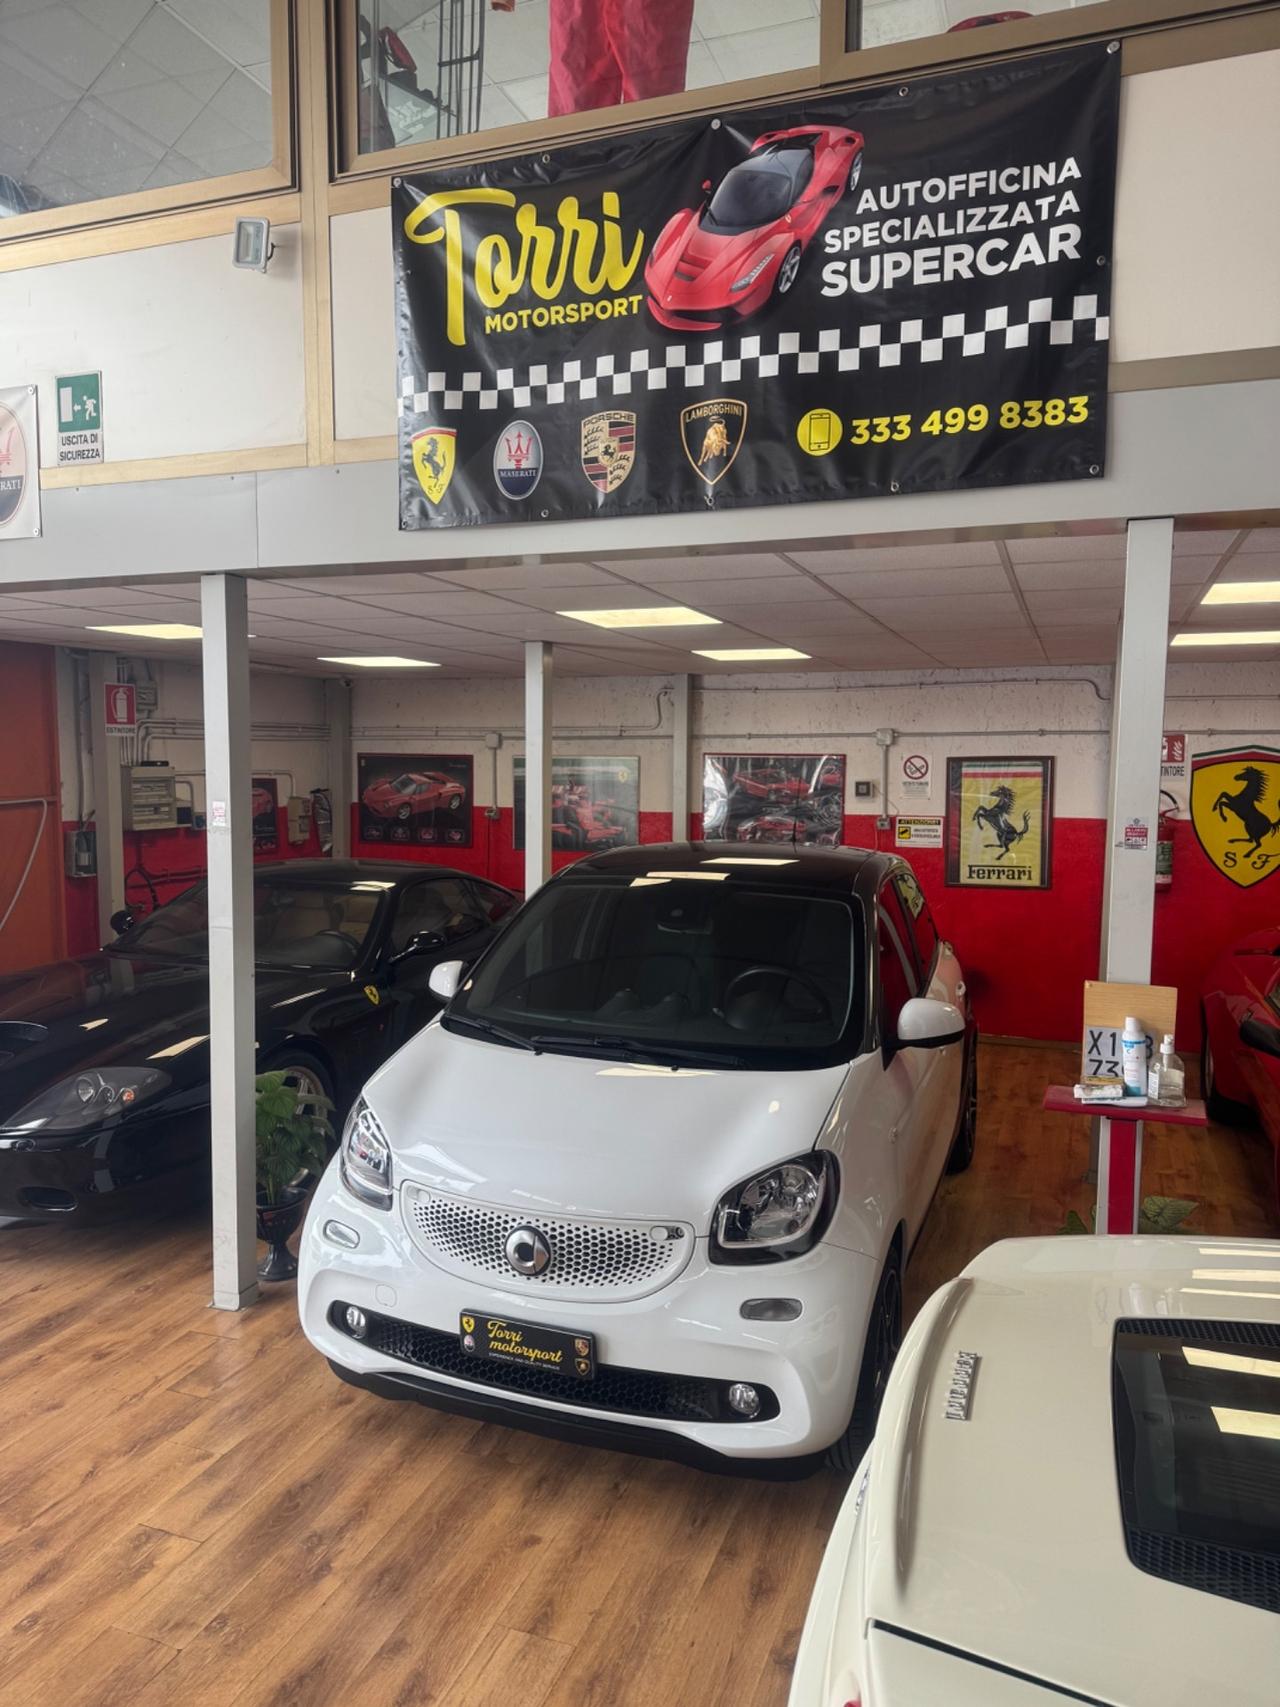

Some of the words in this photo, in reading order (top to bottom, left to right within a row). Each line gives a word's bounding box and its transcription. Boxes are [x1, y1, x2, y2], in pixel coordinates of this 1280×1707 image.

[856, 157, 1082, 215] AUTOFFICINA
[824, 190, 1080, 254] SPECIALIZZATA
[404, 187, 645, 346] Torri
[820, 223, 1082, 298] SUPERCAR
[485, 294, 644, 335] MOTORSPORT
[583, 411, 635, 427] PORSCHE
[686, 402, 743, 423] LAMBORGHINI
[850, 414, 912, 445] 333
[921, 404, 989, 436] 499
[1000, 395, 1089, 430] 8383
[61, 434, 89, 446] USCITA
[90, 433, 99, 444] DI
[59, 449, 101, 462] SICUREZZA
[500, 469, 537, 478] MASERATI
[1223, 851, 1238, 868] S
[1251, 852, 1280, 870] F
[967, 864, 1032, 880] Ferrari
[487, 1320, 523, 1342] Torri
[489, 1340, 563, 1363] motorsport
